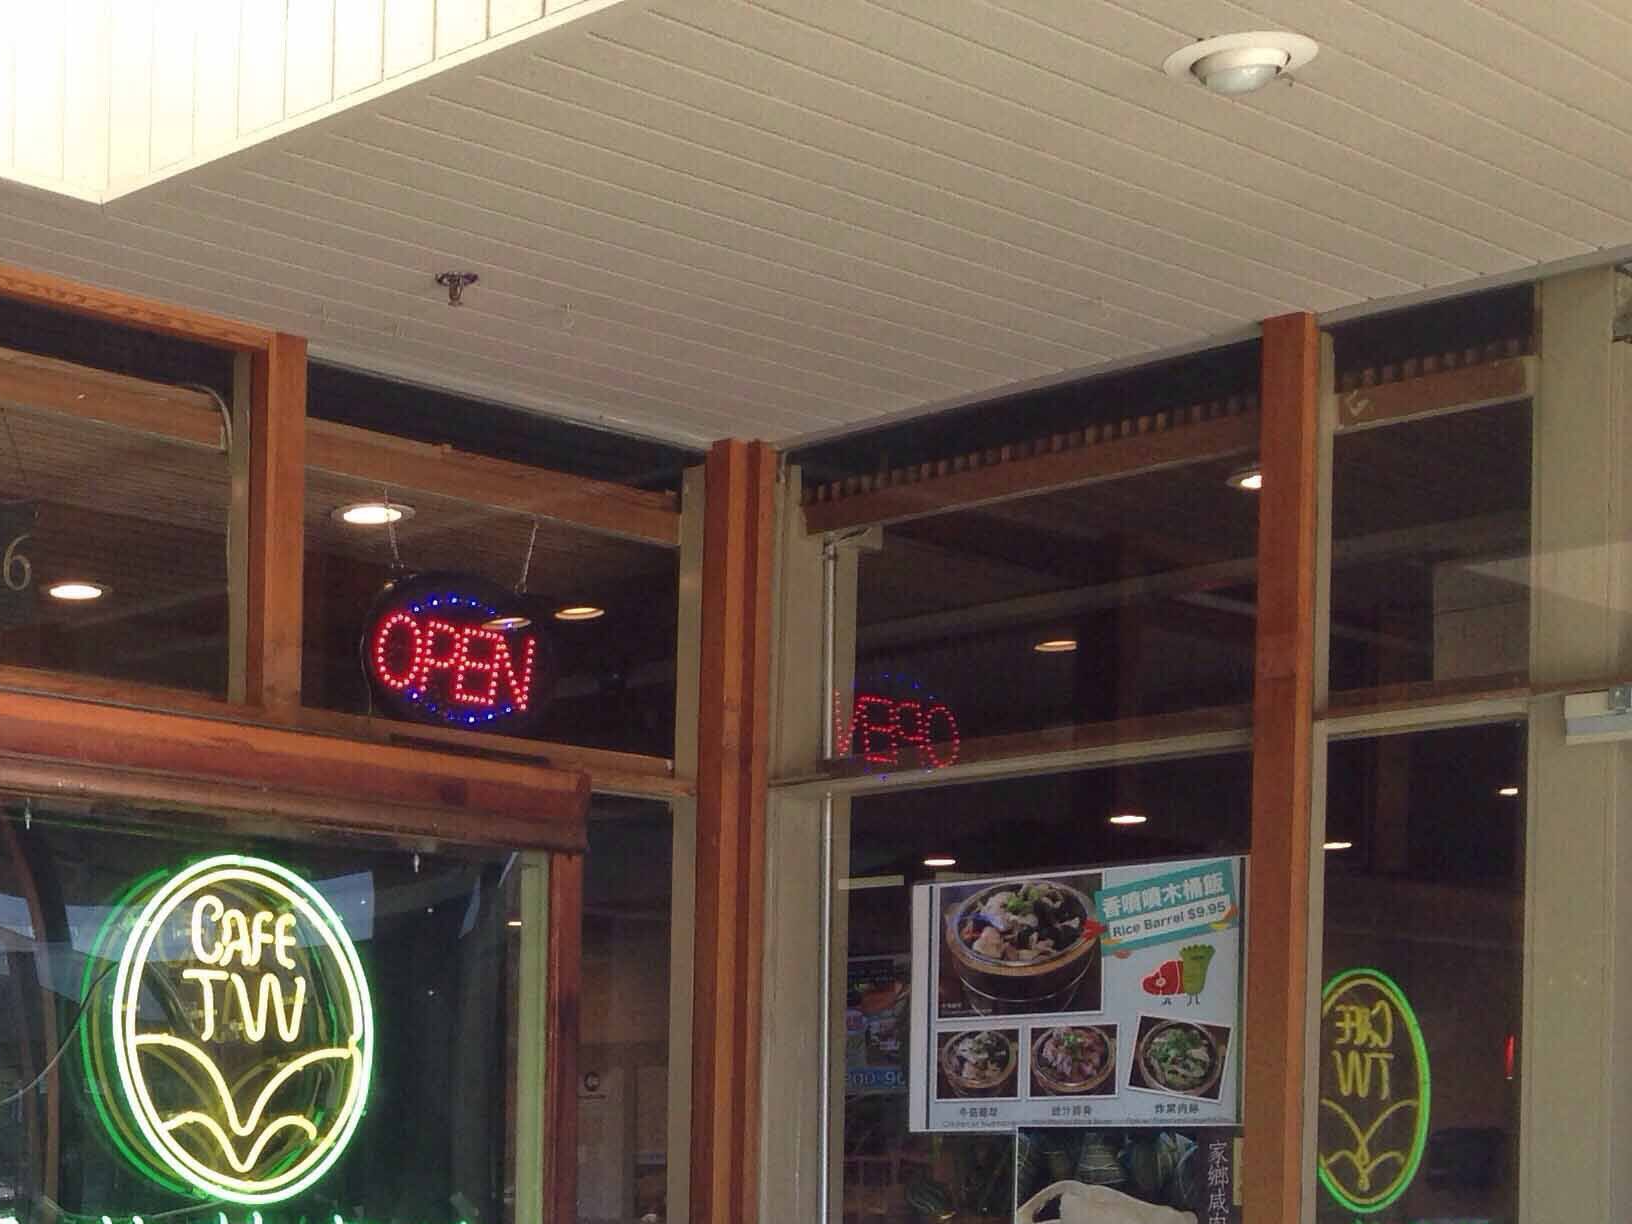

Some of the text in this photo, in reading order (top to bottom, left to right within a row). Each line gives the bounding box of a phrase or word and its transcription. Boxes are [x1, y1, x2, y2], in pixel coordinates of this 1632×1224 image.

[371, 608, 537, 712] OPEN
[191, 895, 297, 970] CAFE
[1112, 900, 1227, 938] Rice Barrel $9.95
[182, 968, 306, 1043] TW
